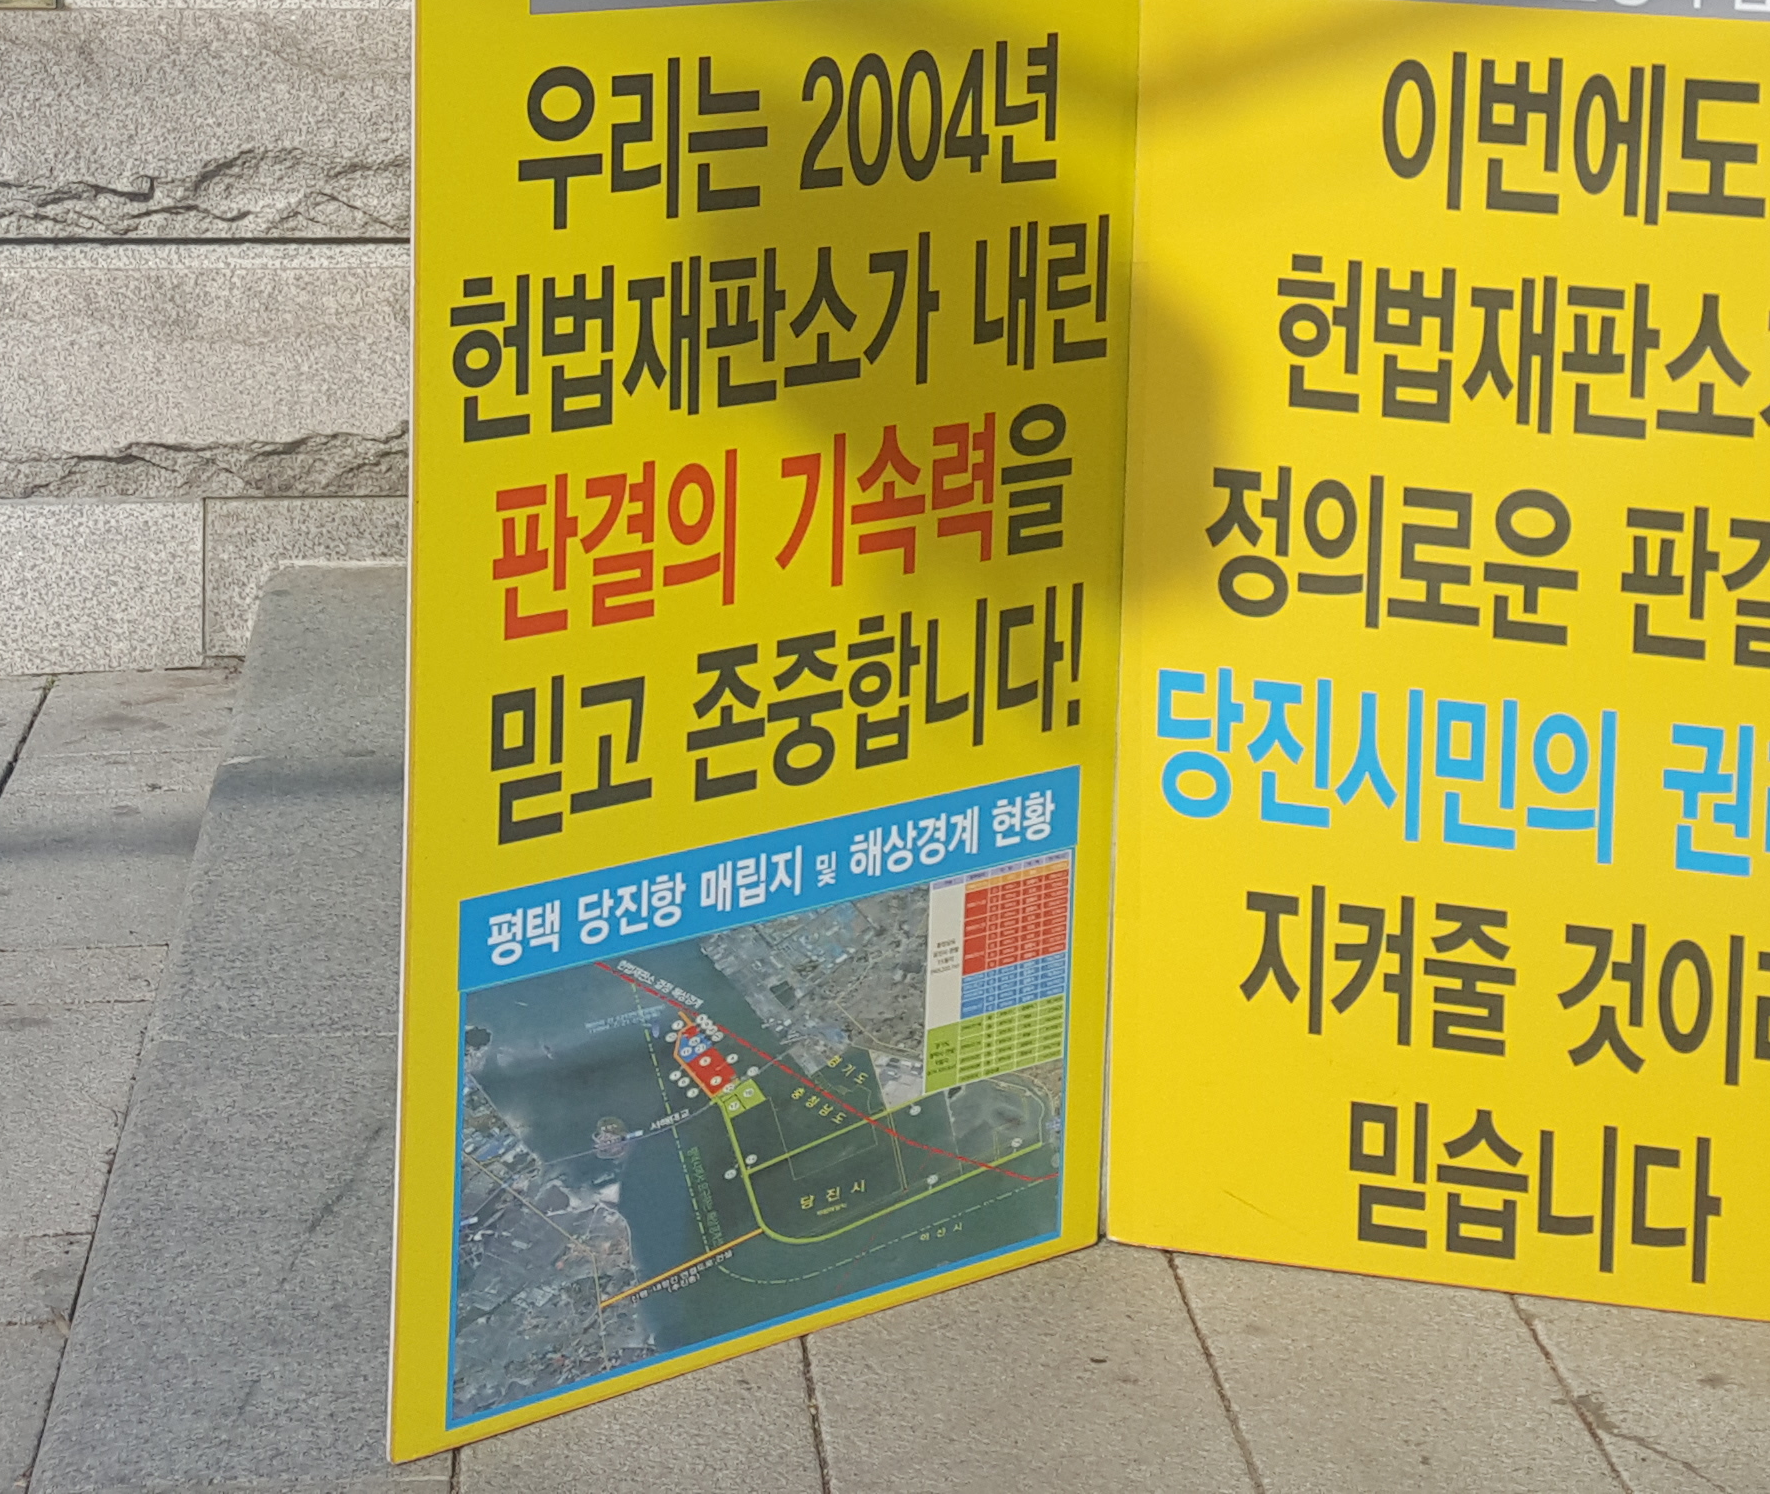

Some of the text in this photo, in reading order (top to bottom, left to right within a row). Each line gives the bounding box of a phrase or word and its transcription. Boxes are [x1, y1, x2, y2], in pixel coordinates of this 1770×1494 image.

[517, 32, 1060, 230] 우리는 2004년
[1381, 51, 1768, 226] 이번에도
[449, 214, 1111, 443] 헌법재판소가 내린
[492, 403, 1073, 641] 판결의 기속력을
[1205, 465, 1579, 647] 정의로운
[489, 581, 1085, 846] 믿고 존중합니다!
[1155, 666, 1619, 865] 당진시민의
[487, 902, 560, 966] 평택
[577, 880, 686, 940] 당진항
[699, 843, 803, 913] 매립지
[815, 850, 837, 886] 및
[849, 804, 981, 878] 해상경계
[992, 789, 1057, 848] 현황
[1240, 884, 1518, 1058] 지켜줄
[791, 1087, 848, 1125] 충청남도
[1347, 1100, 1723, 1285] 믿습니다
